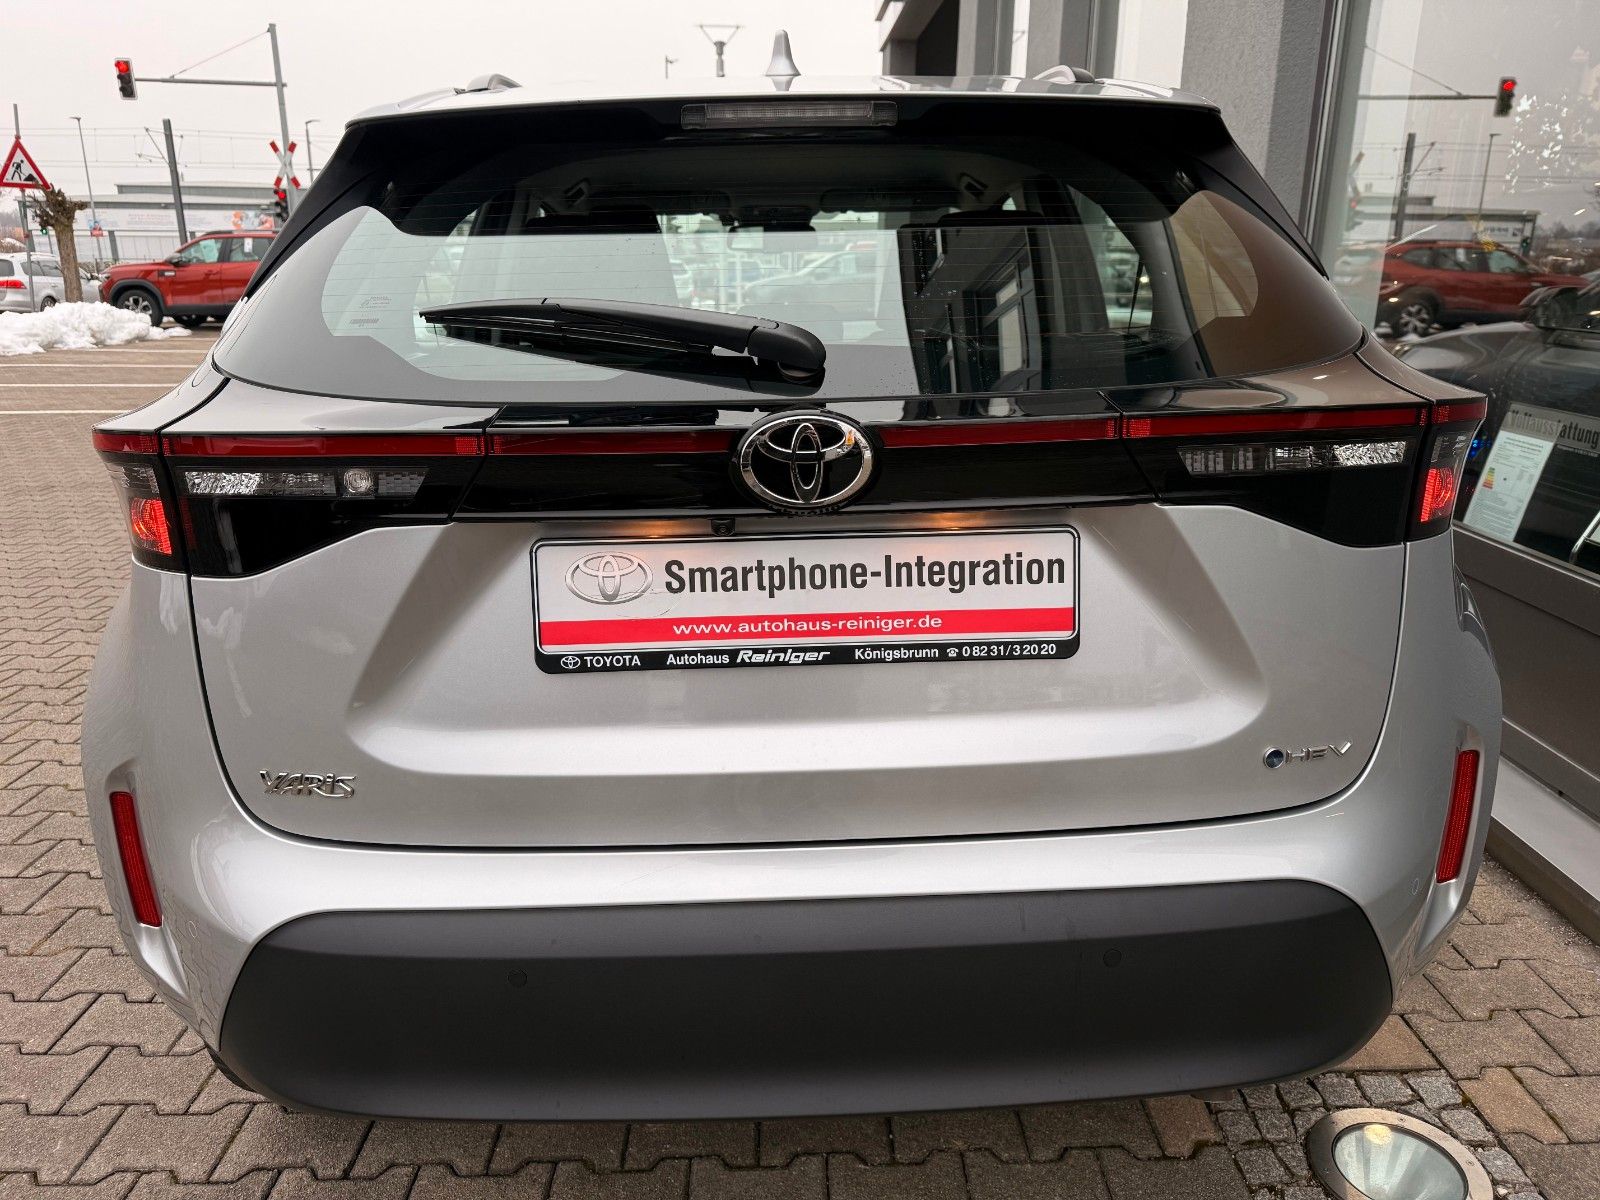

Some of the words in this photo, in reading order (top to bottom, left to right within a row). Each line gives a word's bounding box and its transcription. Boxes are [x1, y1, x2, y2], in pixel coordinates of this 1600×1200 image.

[664, 551, 1065, 599] Smartphone-Integration
[673, 614, 942, 635] www.autohaus-reiniger.de
[584, 655, 641, 668] TOYOTA
[666, 653, 730, 665] Autohaus
[854, 648, 939, 661] Königsbrunn
